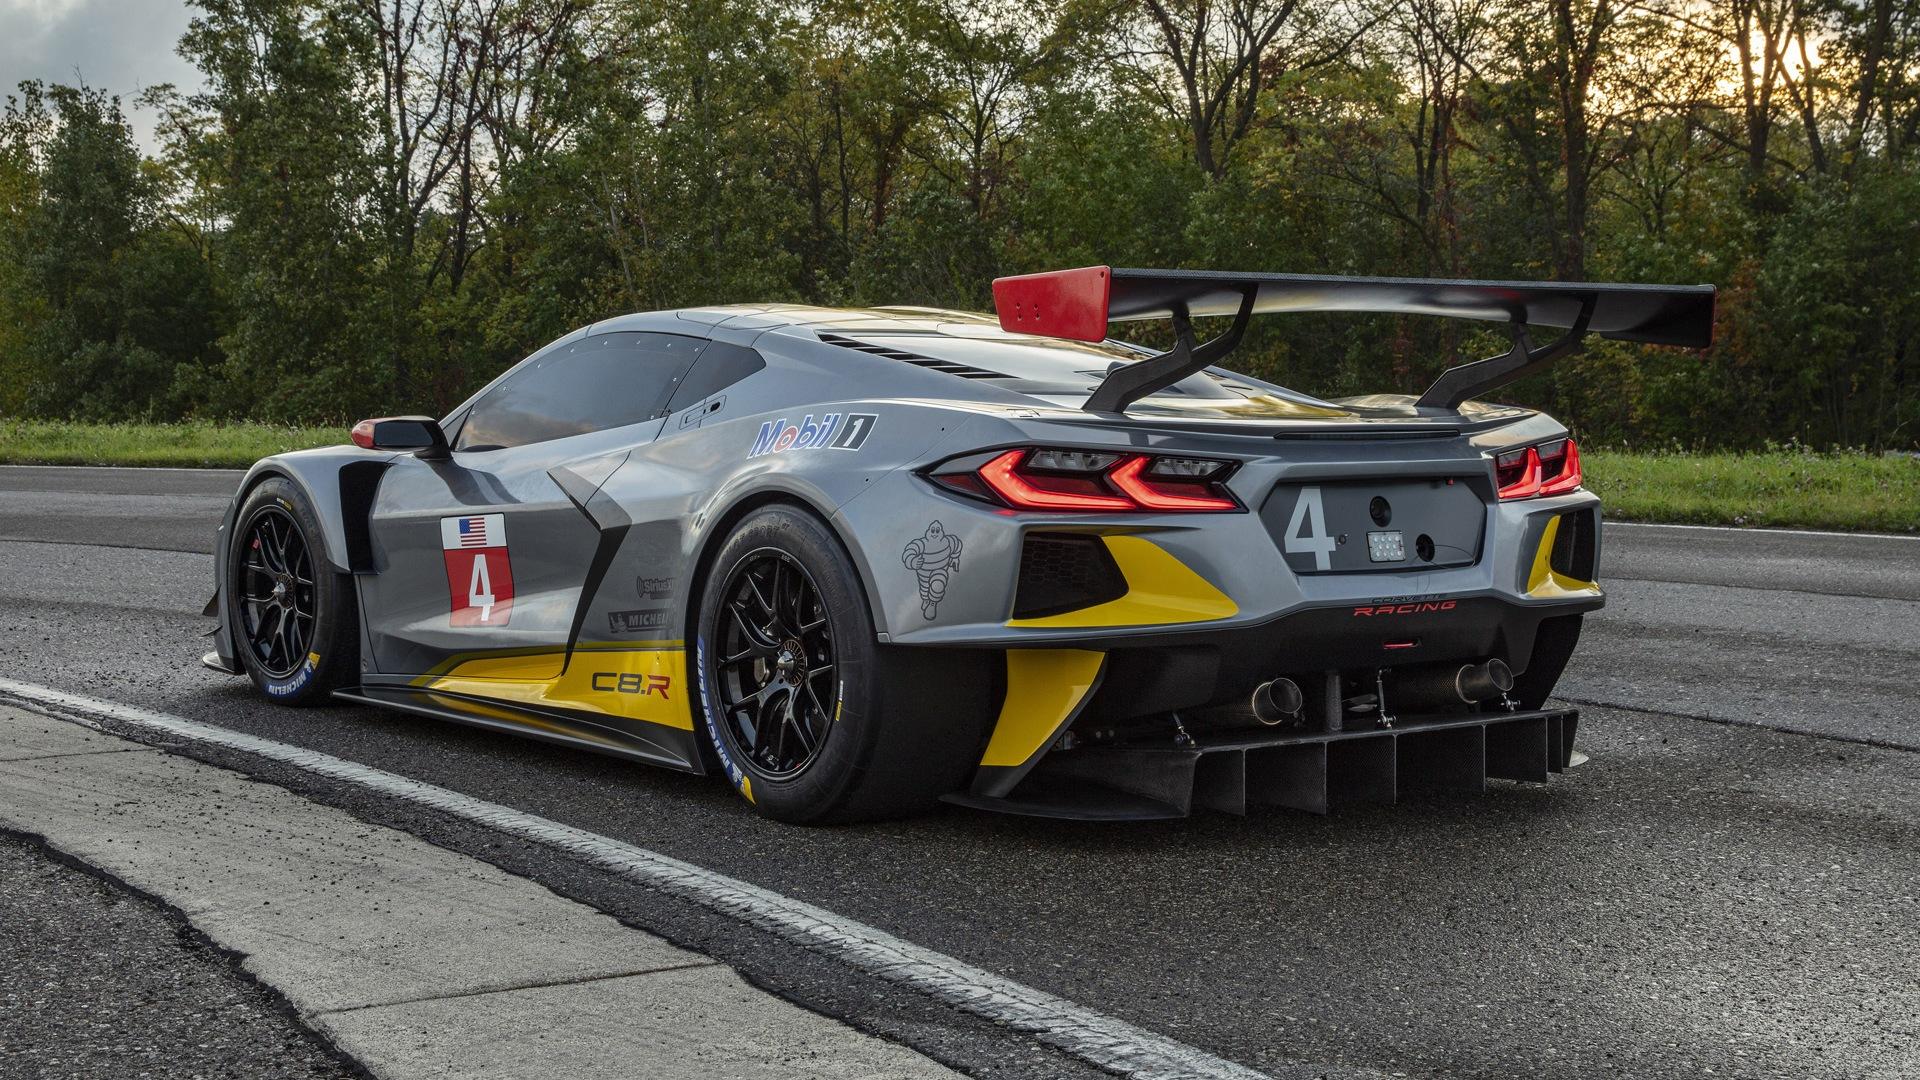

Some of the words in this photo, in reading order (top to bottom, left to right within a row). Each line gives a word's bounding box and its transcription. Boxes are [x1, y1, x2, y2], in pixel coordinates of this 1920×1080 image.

[746, 413, 842, 460] Mobil
[1284, 486, 1336, 571] 4
[469, 553, 495, 622] 4
[643, 577, 673, 594] SiriusX
[1353, 601, 1457, 616] RACING
[268, 671, 307, 695] MICHELIN
[592, 672, 671, 700] C8.R
[697, 646, 730, 769] MICHELIN
